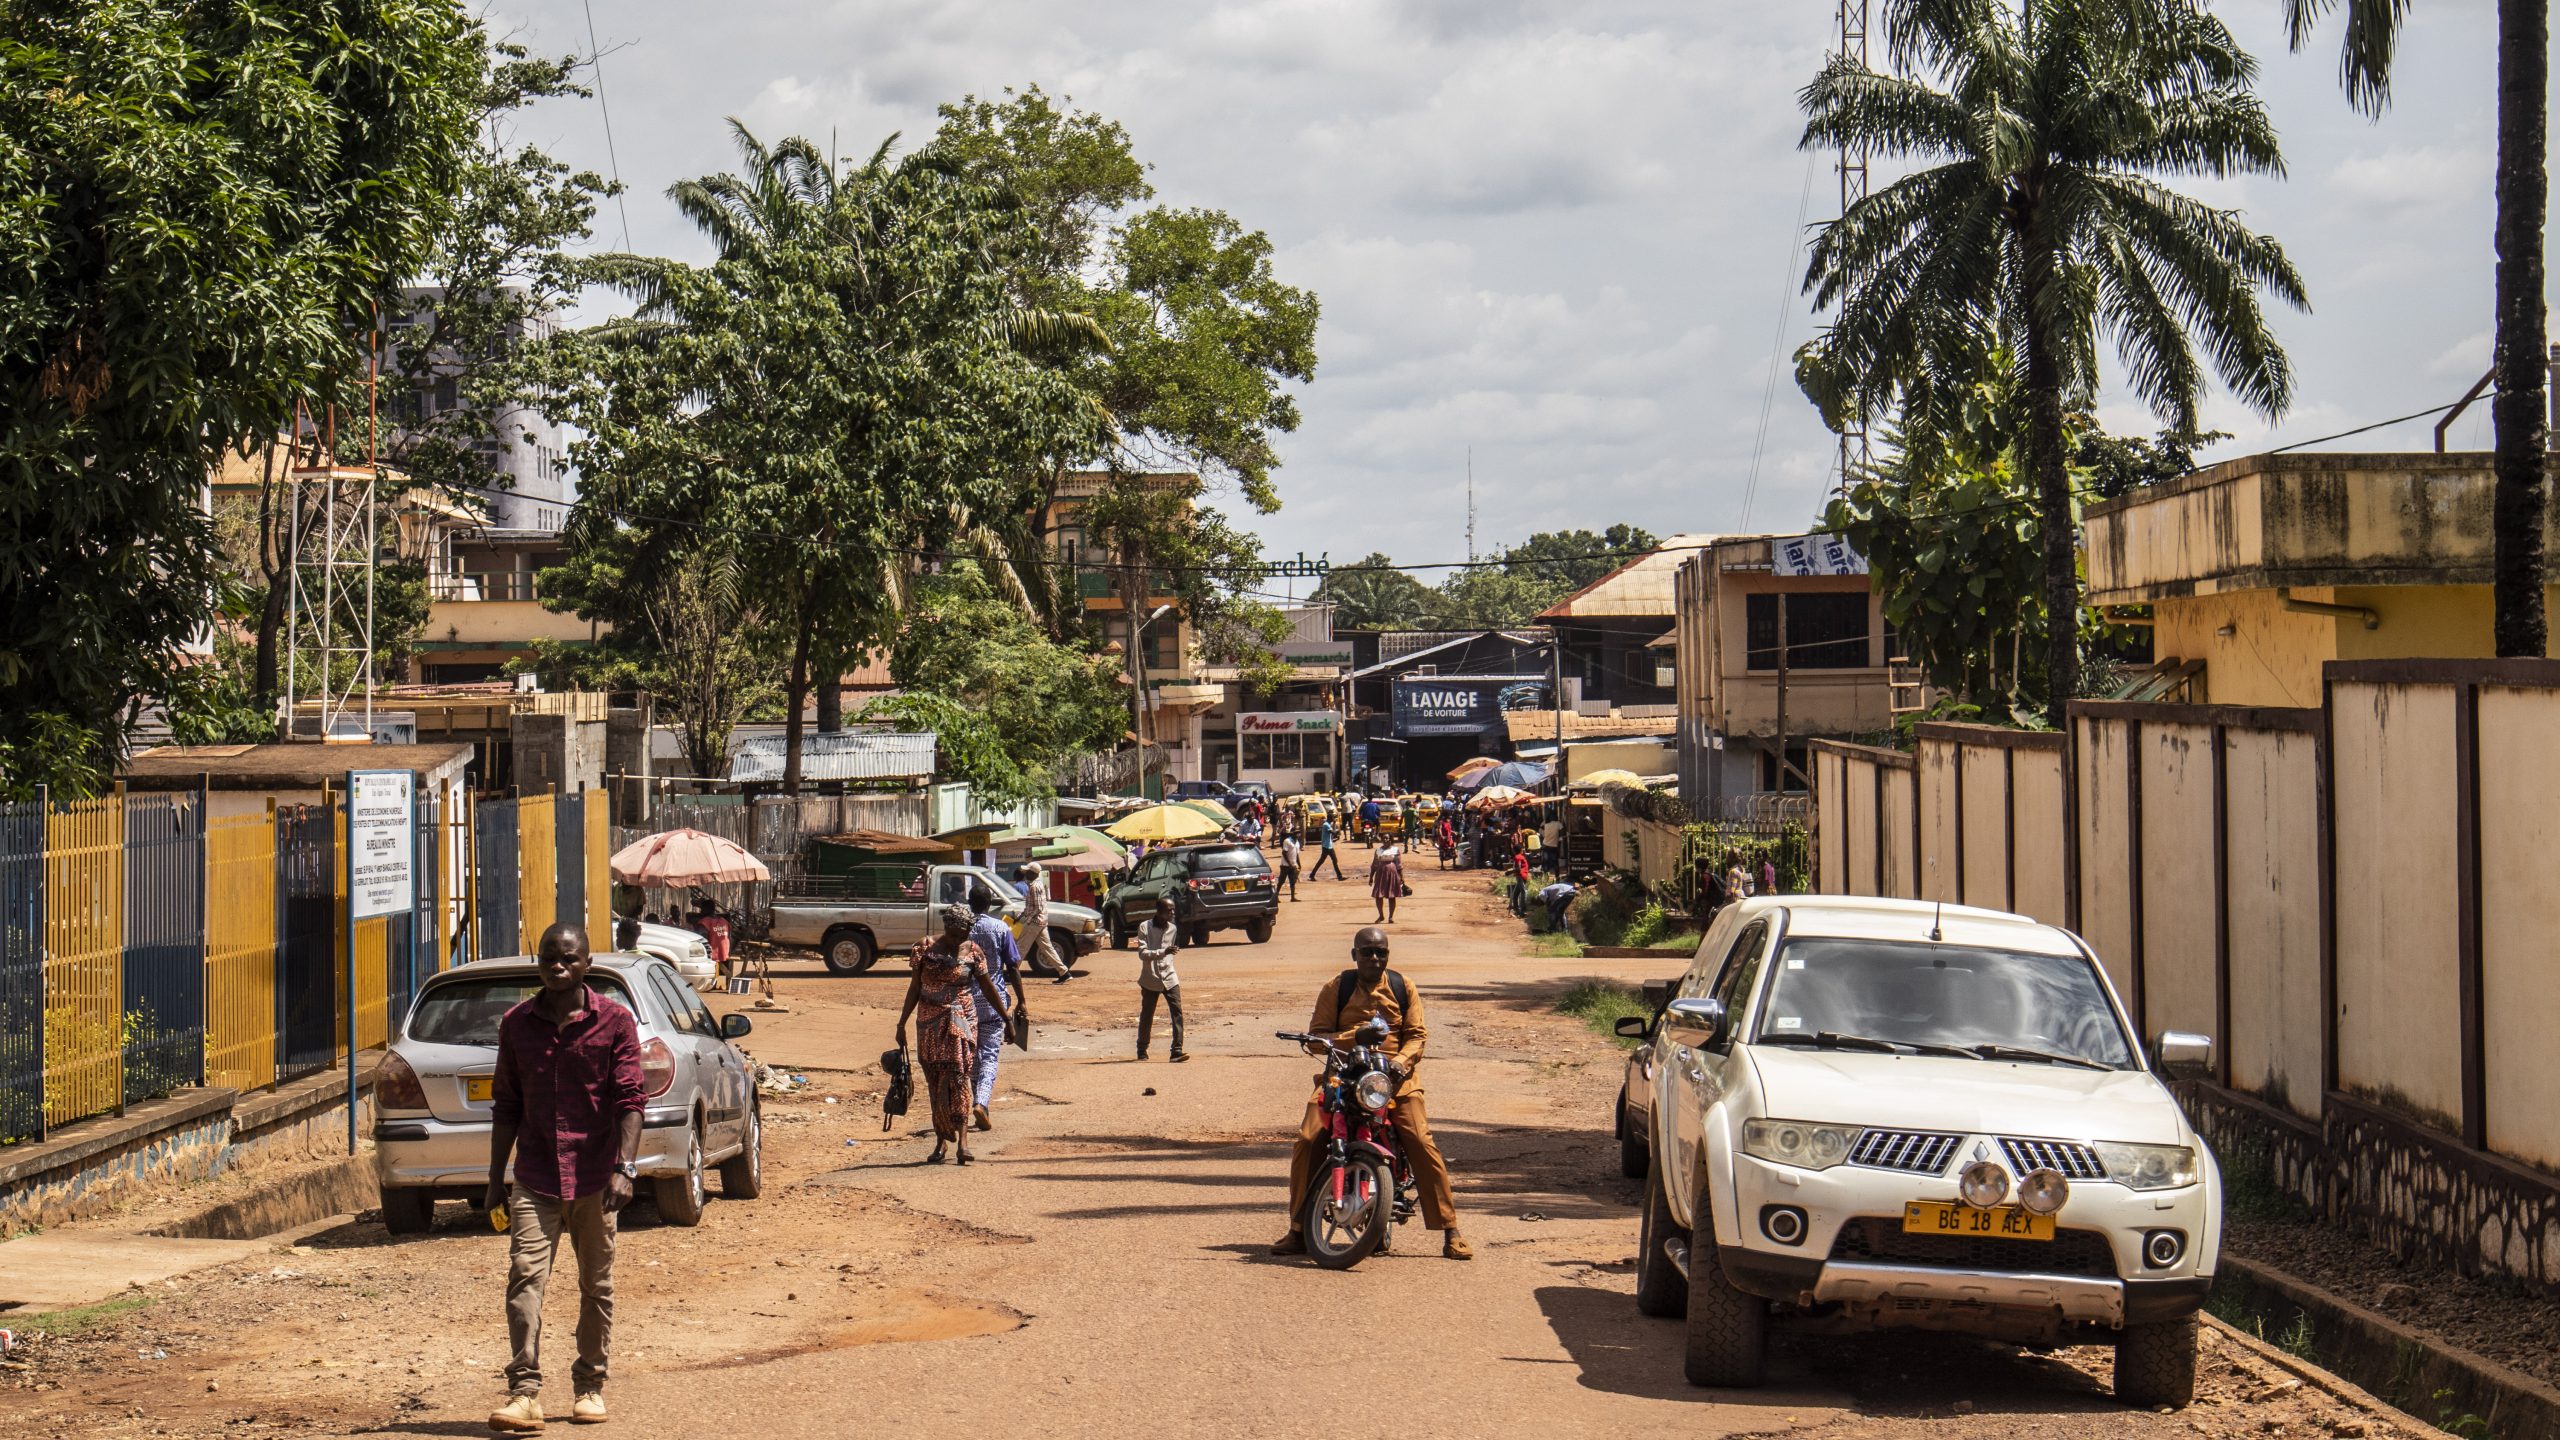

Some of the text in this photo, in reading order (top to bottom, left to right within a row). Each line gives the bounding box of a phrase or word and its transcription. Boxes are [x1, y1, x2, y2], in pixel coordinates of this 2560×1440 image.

[1412, 691, 1478, 708] LAVAGE
[1423, 709, 1467, 717] DE VOITURE
[1241, 715, 1332, 731] Prima Snack
[1938, 1209, 2033, 1235] BG 18 AEX
